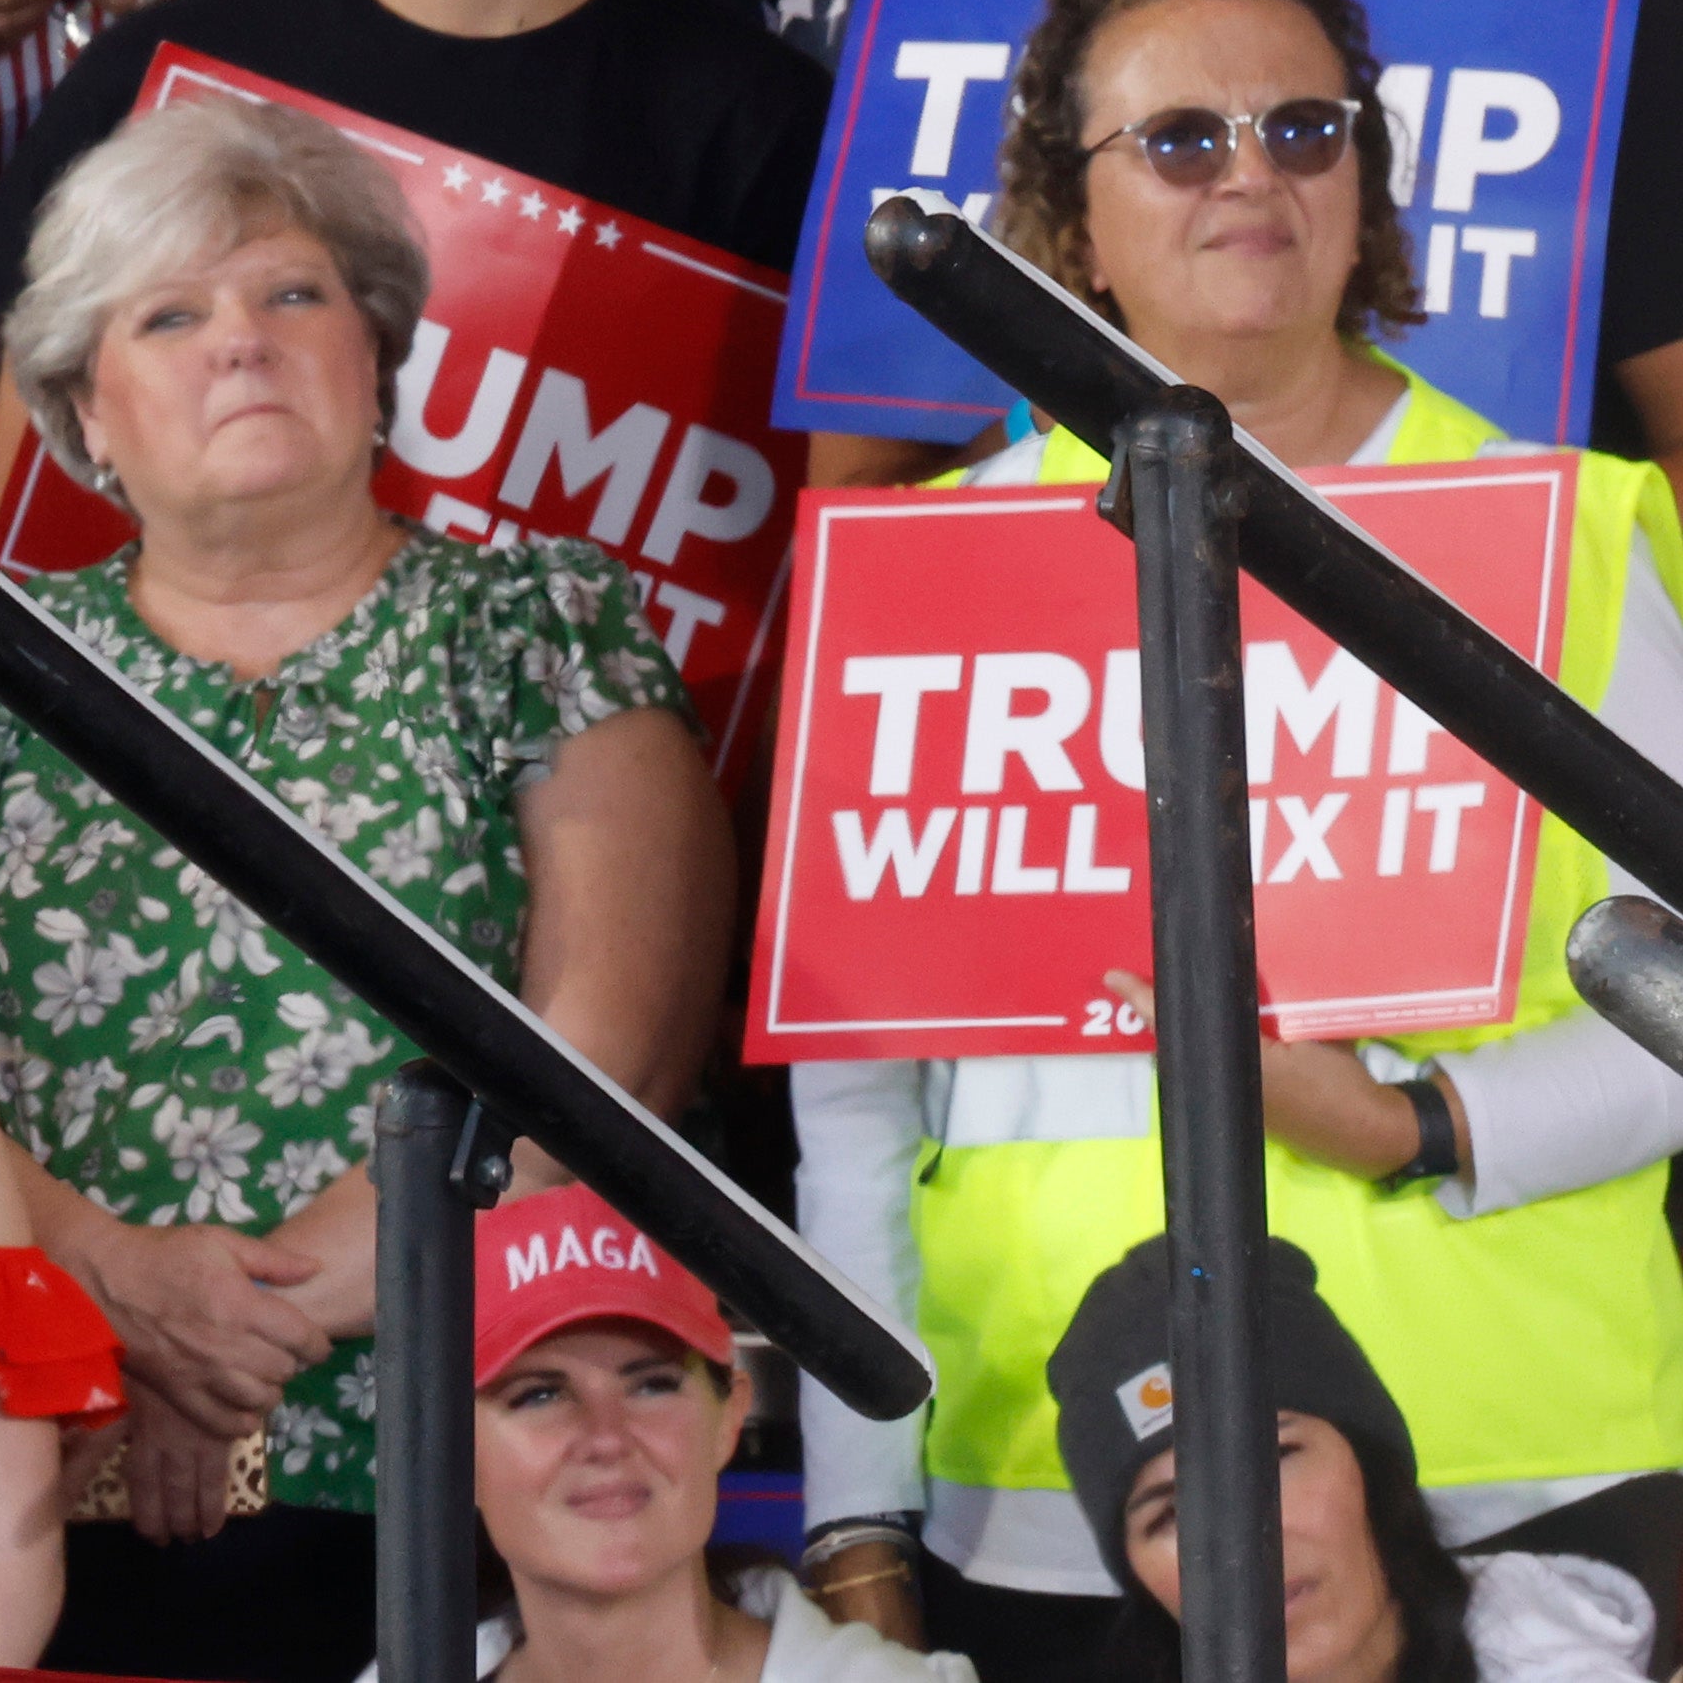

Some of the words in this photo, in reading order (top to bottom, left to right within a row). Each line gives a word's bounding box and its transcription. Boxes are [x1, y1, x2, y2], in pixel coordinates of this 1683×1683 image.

[1424, 224, 1537, 318] IT
[388, 317, 776, 567] UMP
[833, 804, 1131, 901] WILL
[1377, 782, 1486, 878] IT
[504, 1224, 660, 1292] MAGA
